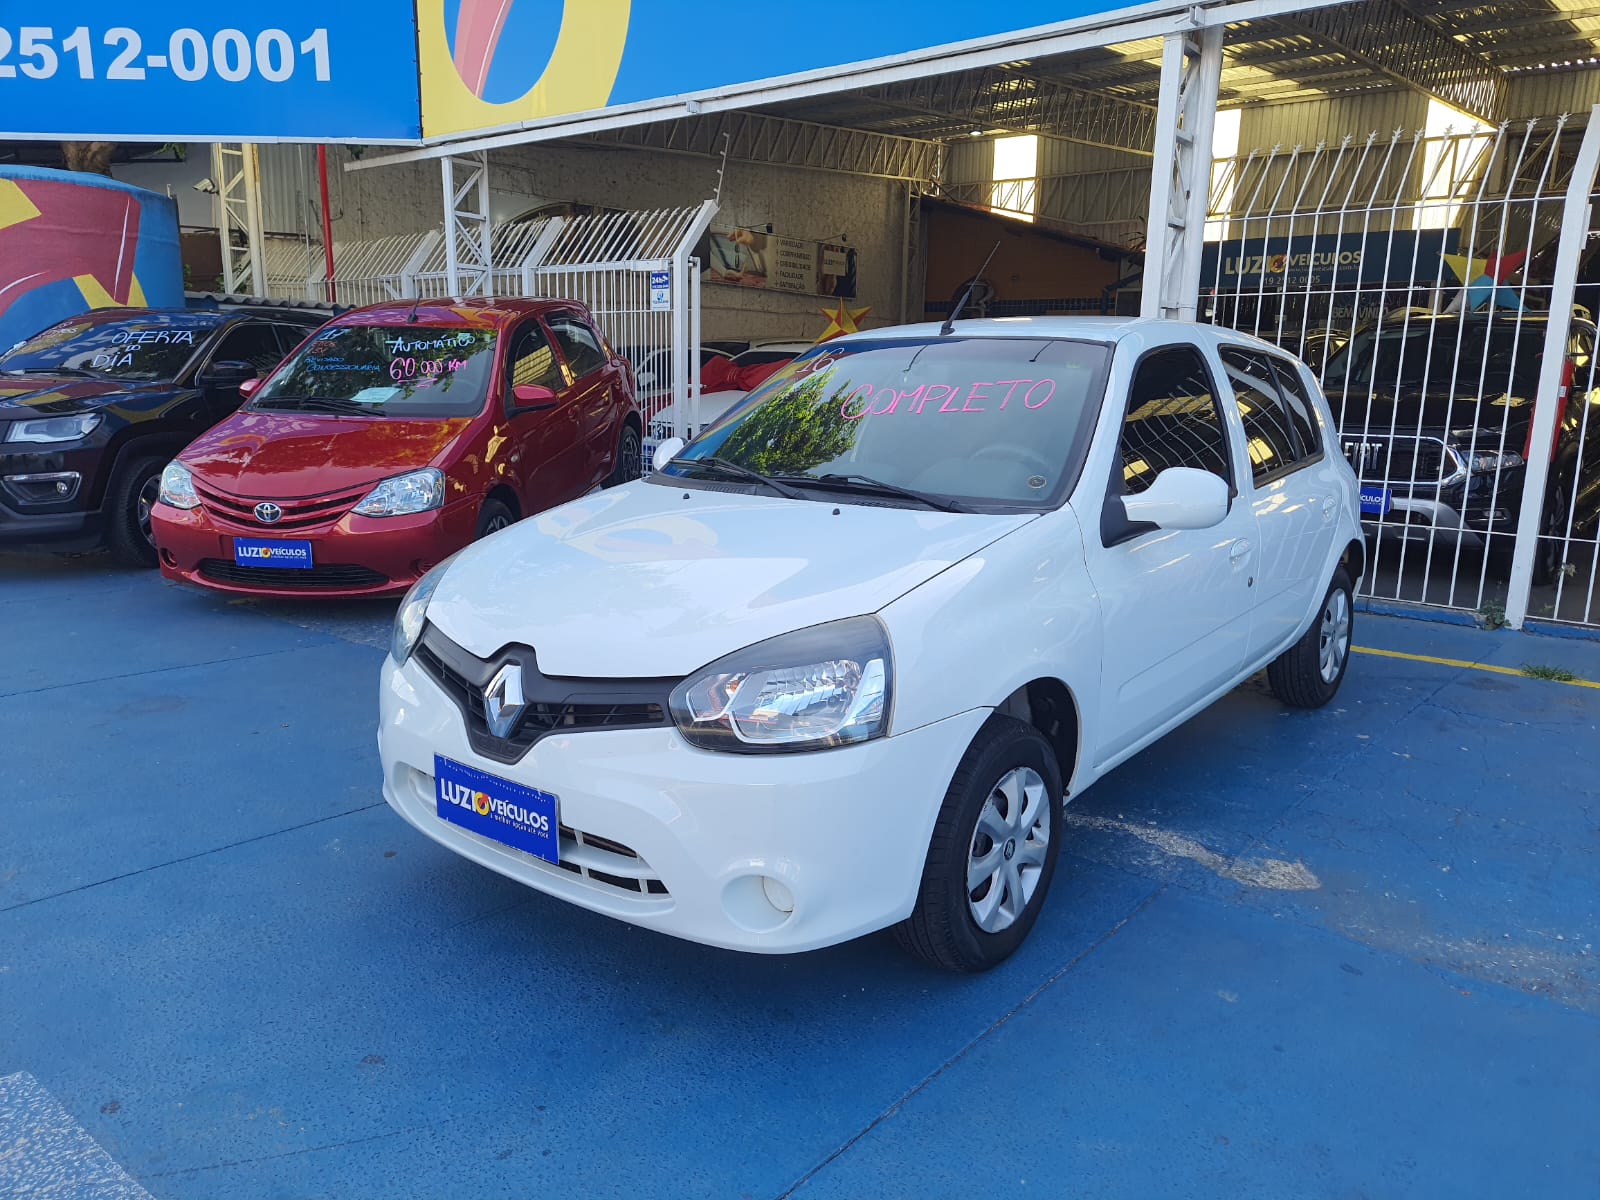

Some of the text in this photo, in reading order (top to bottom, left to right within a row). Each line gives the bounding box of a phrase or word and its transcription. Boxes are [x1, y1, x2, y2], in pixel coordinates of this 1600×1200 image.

[0, 26, 331, 82] 2512-0001
[1224, 254, 1289, 275] LUZIO
[111, 330, 193, 345] OFERTA
[795, 347, 844, 373] 16
[840, 378, 1056, 420] COMPLETO
[1343, 442, 1382, 470] FIAT
[238, 546, 271, 558] LUZIO
[441, 778, 549, 832] LUZIO VEÍCULOS
